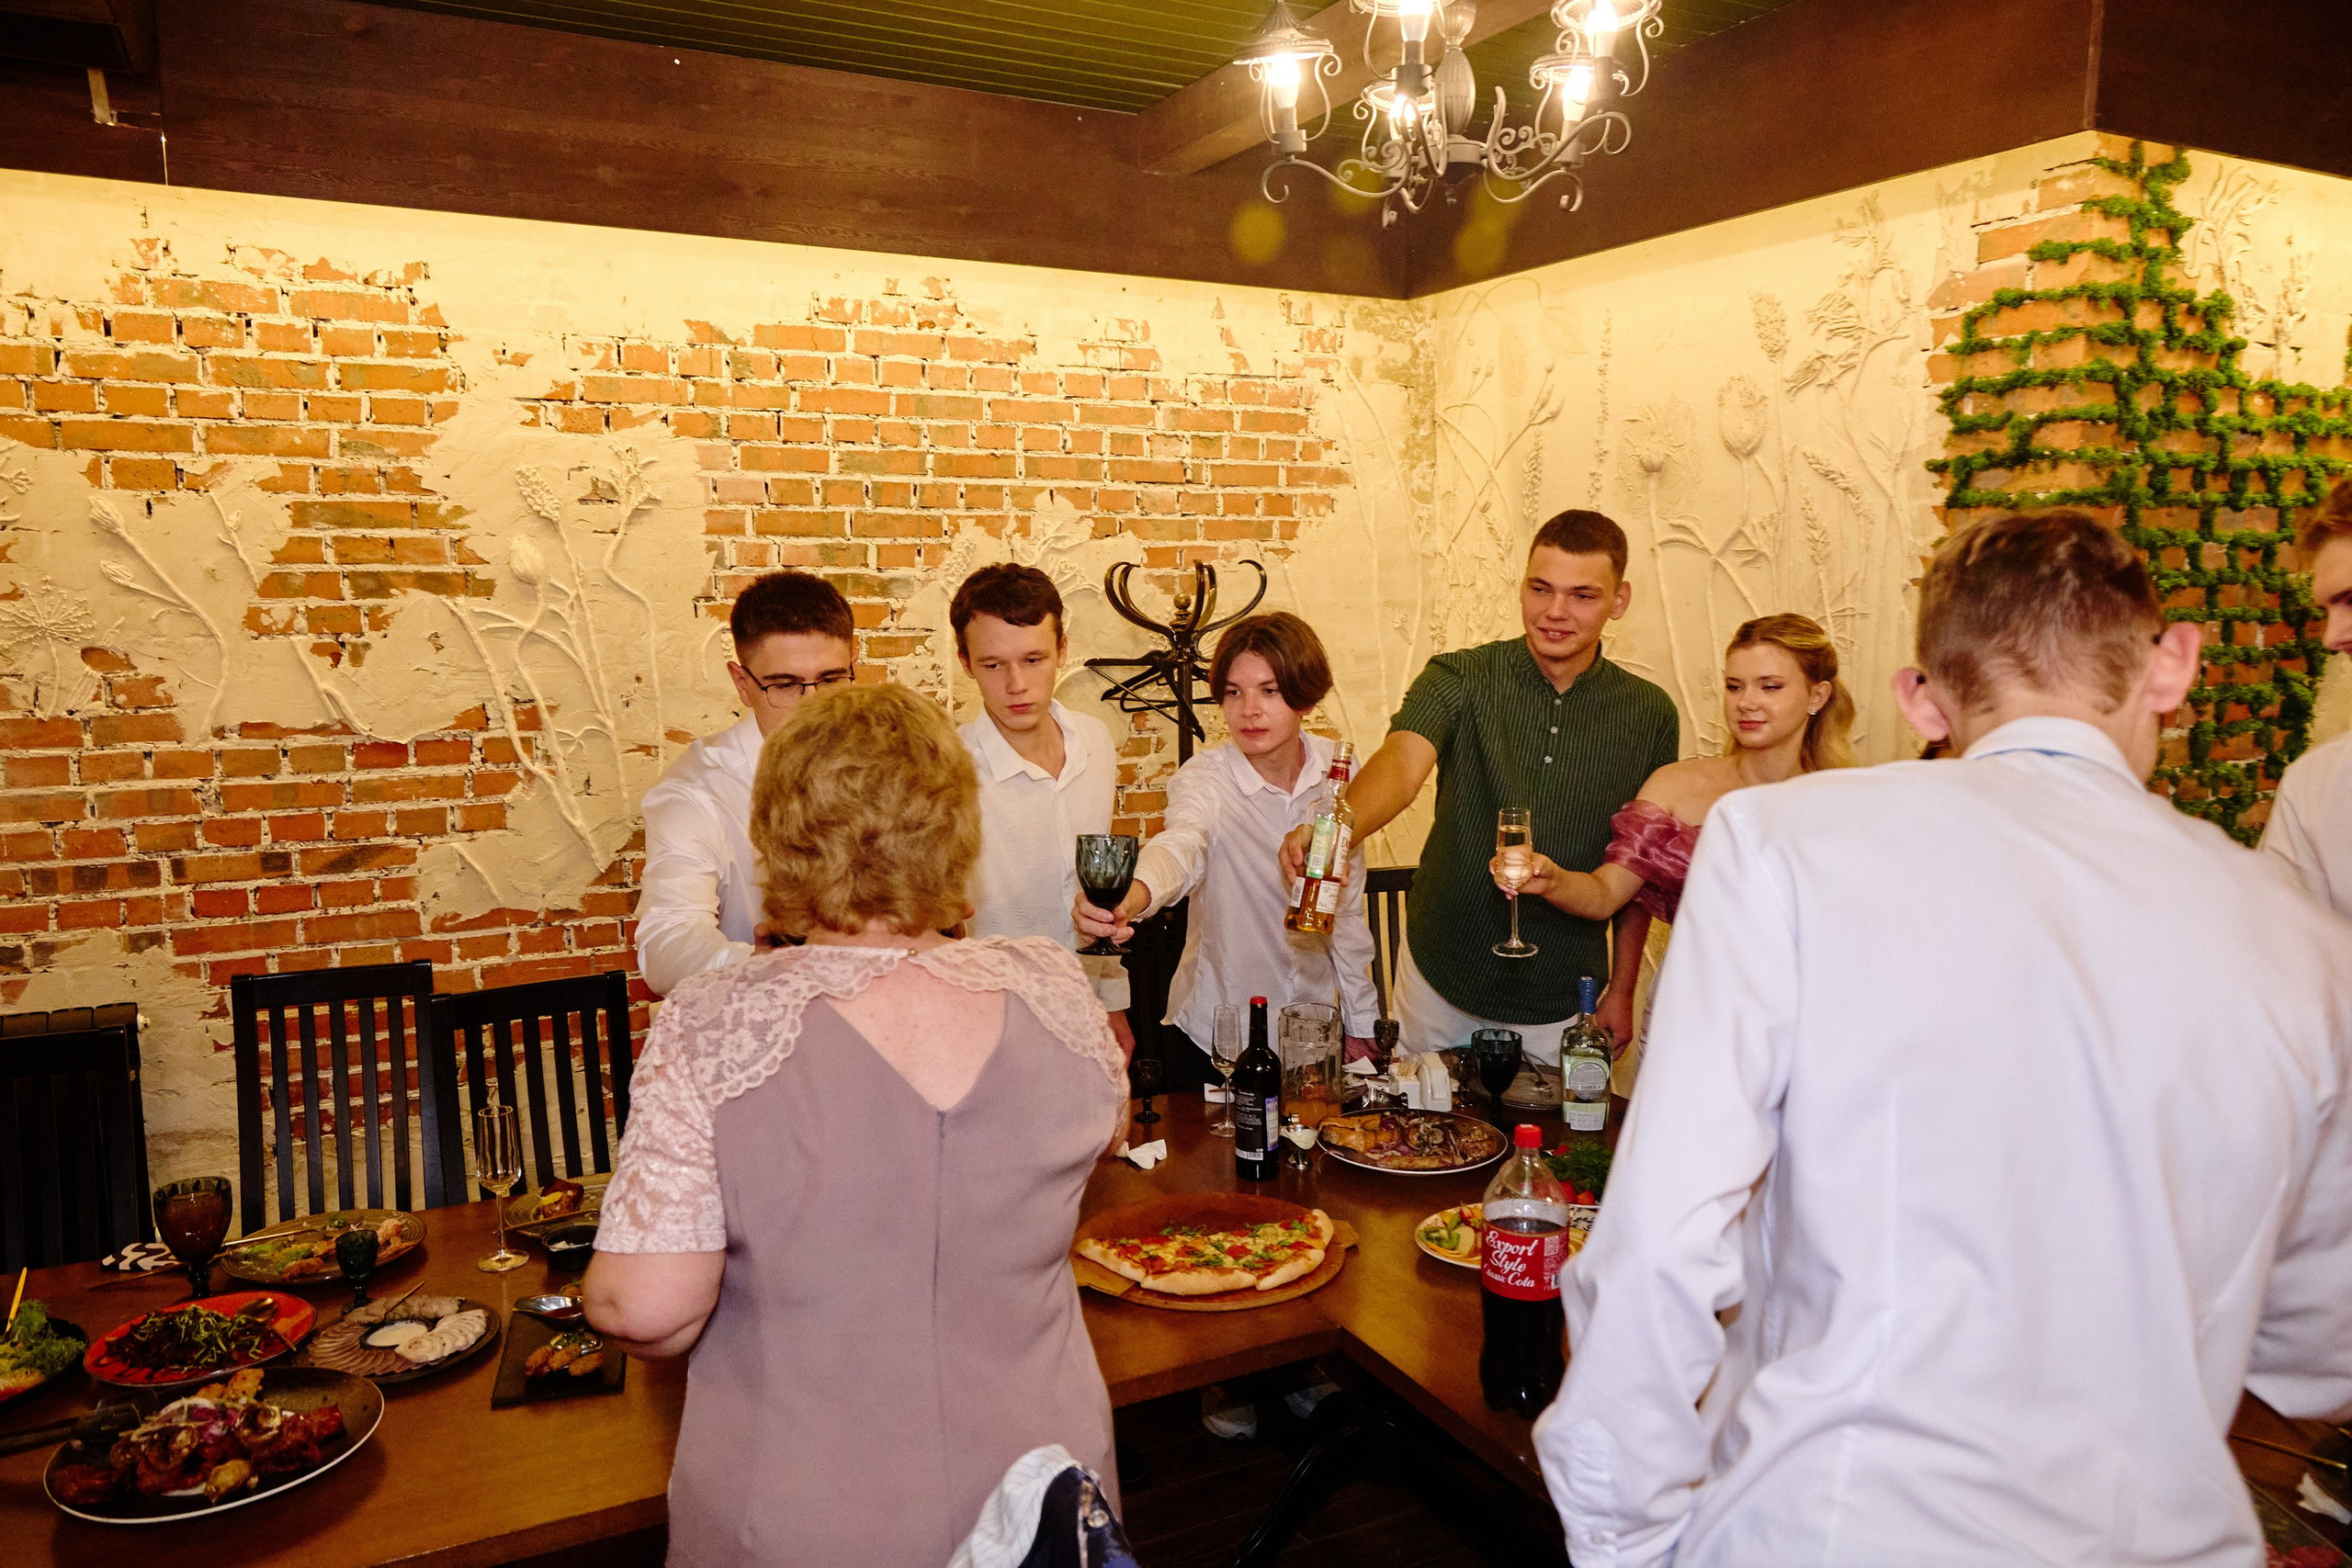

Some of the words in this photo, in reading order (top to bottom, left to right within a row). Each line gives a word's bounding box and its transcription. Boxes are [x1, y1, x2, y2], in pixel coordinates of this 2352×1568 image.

[1486, 1230, 1539, 1258] Export
[1489, 1249, 1527, 1274] Style
[1507, 1271, 1535, 1288] Cola
